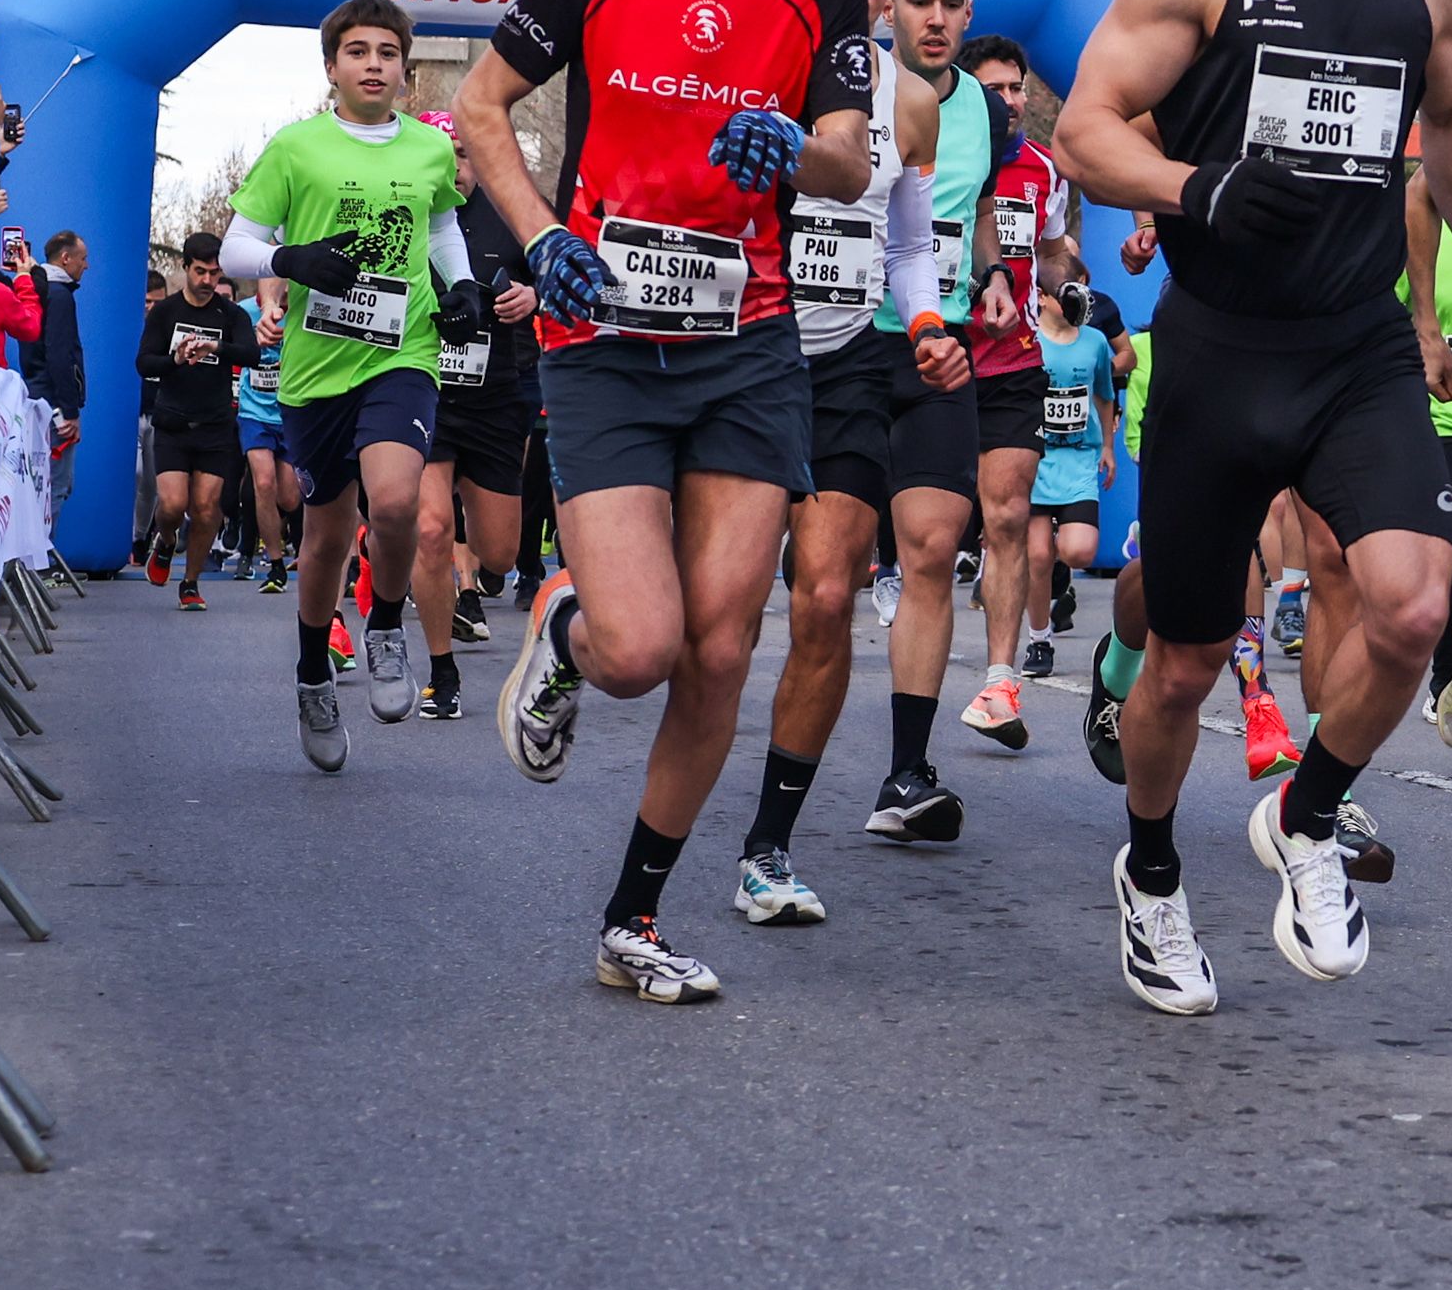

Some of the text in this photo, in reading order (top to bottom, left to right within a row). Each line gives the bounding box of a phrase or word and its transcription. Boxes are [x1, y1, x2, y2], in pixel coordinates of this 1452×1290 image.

[1275, 3, 1296, 12] team
[507, 3, 555, 56] MICA
[1238, 19, 1258, 27] TOP
[1310, 71, 1357, 84] hm hospitales
[1307, 87, 1356, 115] ERIC
[1258, 115, 1288, 126] MITJA
[1258, 123, 1285, 133] SANT
[1301, 121, 1354, 147] 3001
[1253, 130, 1288, 142] CUGAT
[802, 225, 843, 236] hm hospitales
[998, 230, 1016, 241] 074
[647, 239, 698, 253] hm hospitales
[805, 238, 838, 257] PAU
[626, 251, 717, 281] CALSINA
[797, 262, 839, 282] 3186
[640, 284, 694, 307] 3284
[338, 308, 374, 326] 3087
[439, 357, 465, 370] 3214
[1047, 402, 1081, 418] 3319
